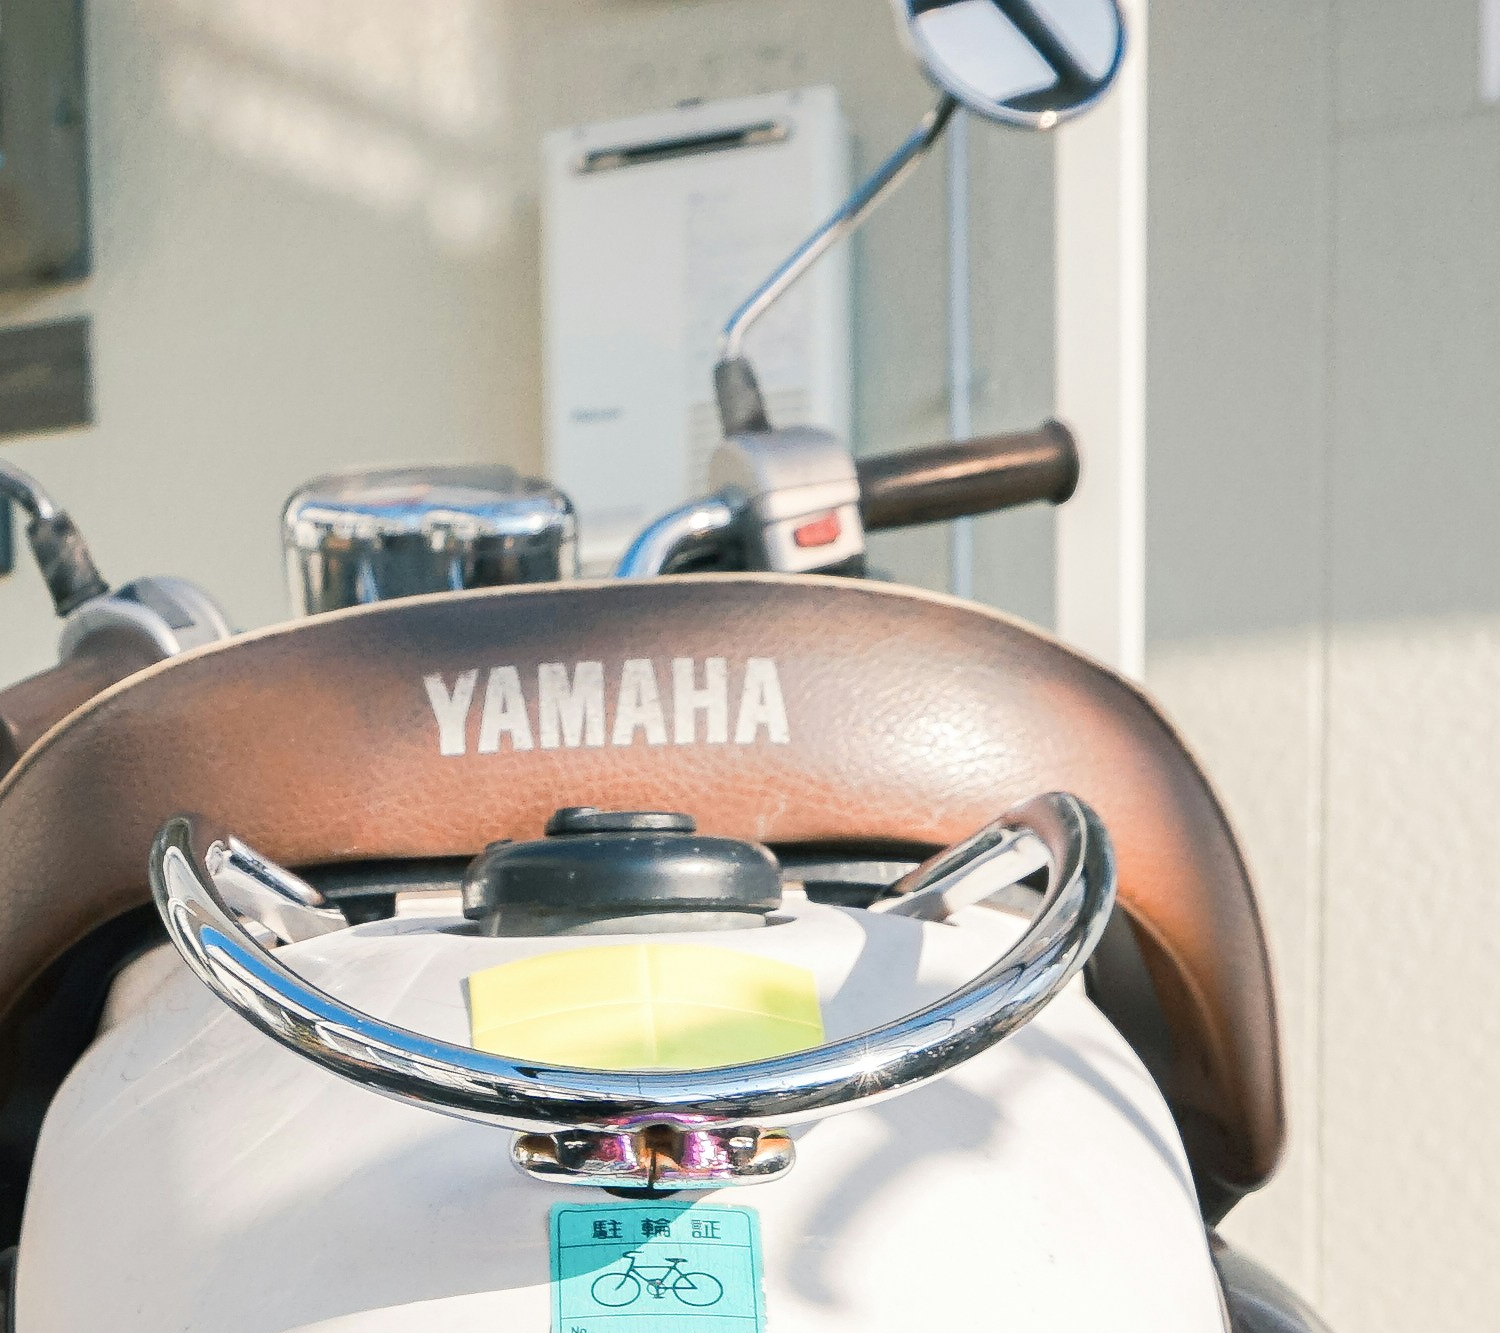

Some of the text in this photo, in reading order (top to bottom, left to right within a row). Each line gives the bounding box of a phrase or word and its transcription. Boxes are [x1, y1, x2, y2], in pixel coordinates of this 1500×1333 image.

[423, 656, 791, 756] YAMAHA
[593, 1218, 722, 1240] 駐輪証
